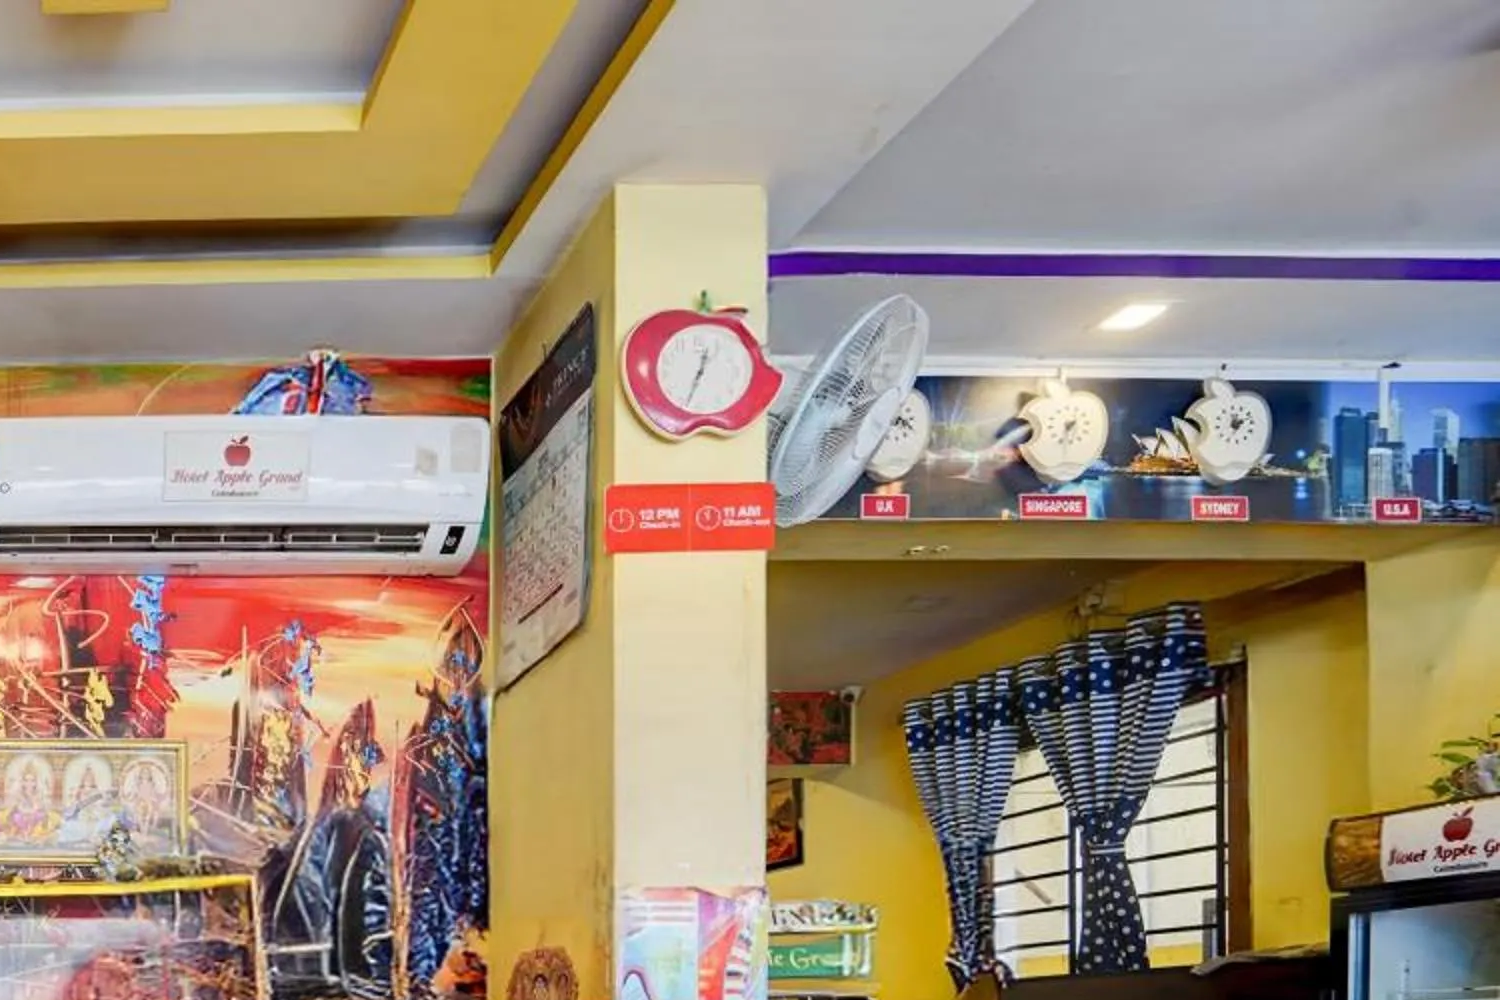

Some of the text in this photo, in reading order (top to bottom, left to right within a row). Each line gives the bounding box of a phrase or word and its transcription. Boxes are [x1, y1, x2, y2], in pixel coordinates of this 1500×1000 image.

[170, 469, 303, 488] Hotel Apple Grand
[723, 506, 761, 518] 11 AM
[1025, 500, 1083, 513] SINGAPORE
[1200, 502, 1240, 515] SYDNEY
[639, 508, 680, 521] 12 PM
[1388, 848, 1427, 866] Hotel
[1433, 844, 1477, 862] Apple
